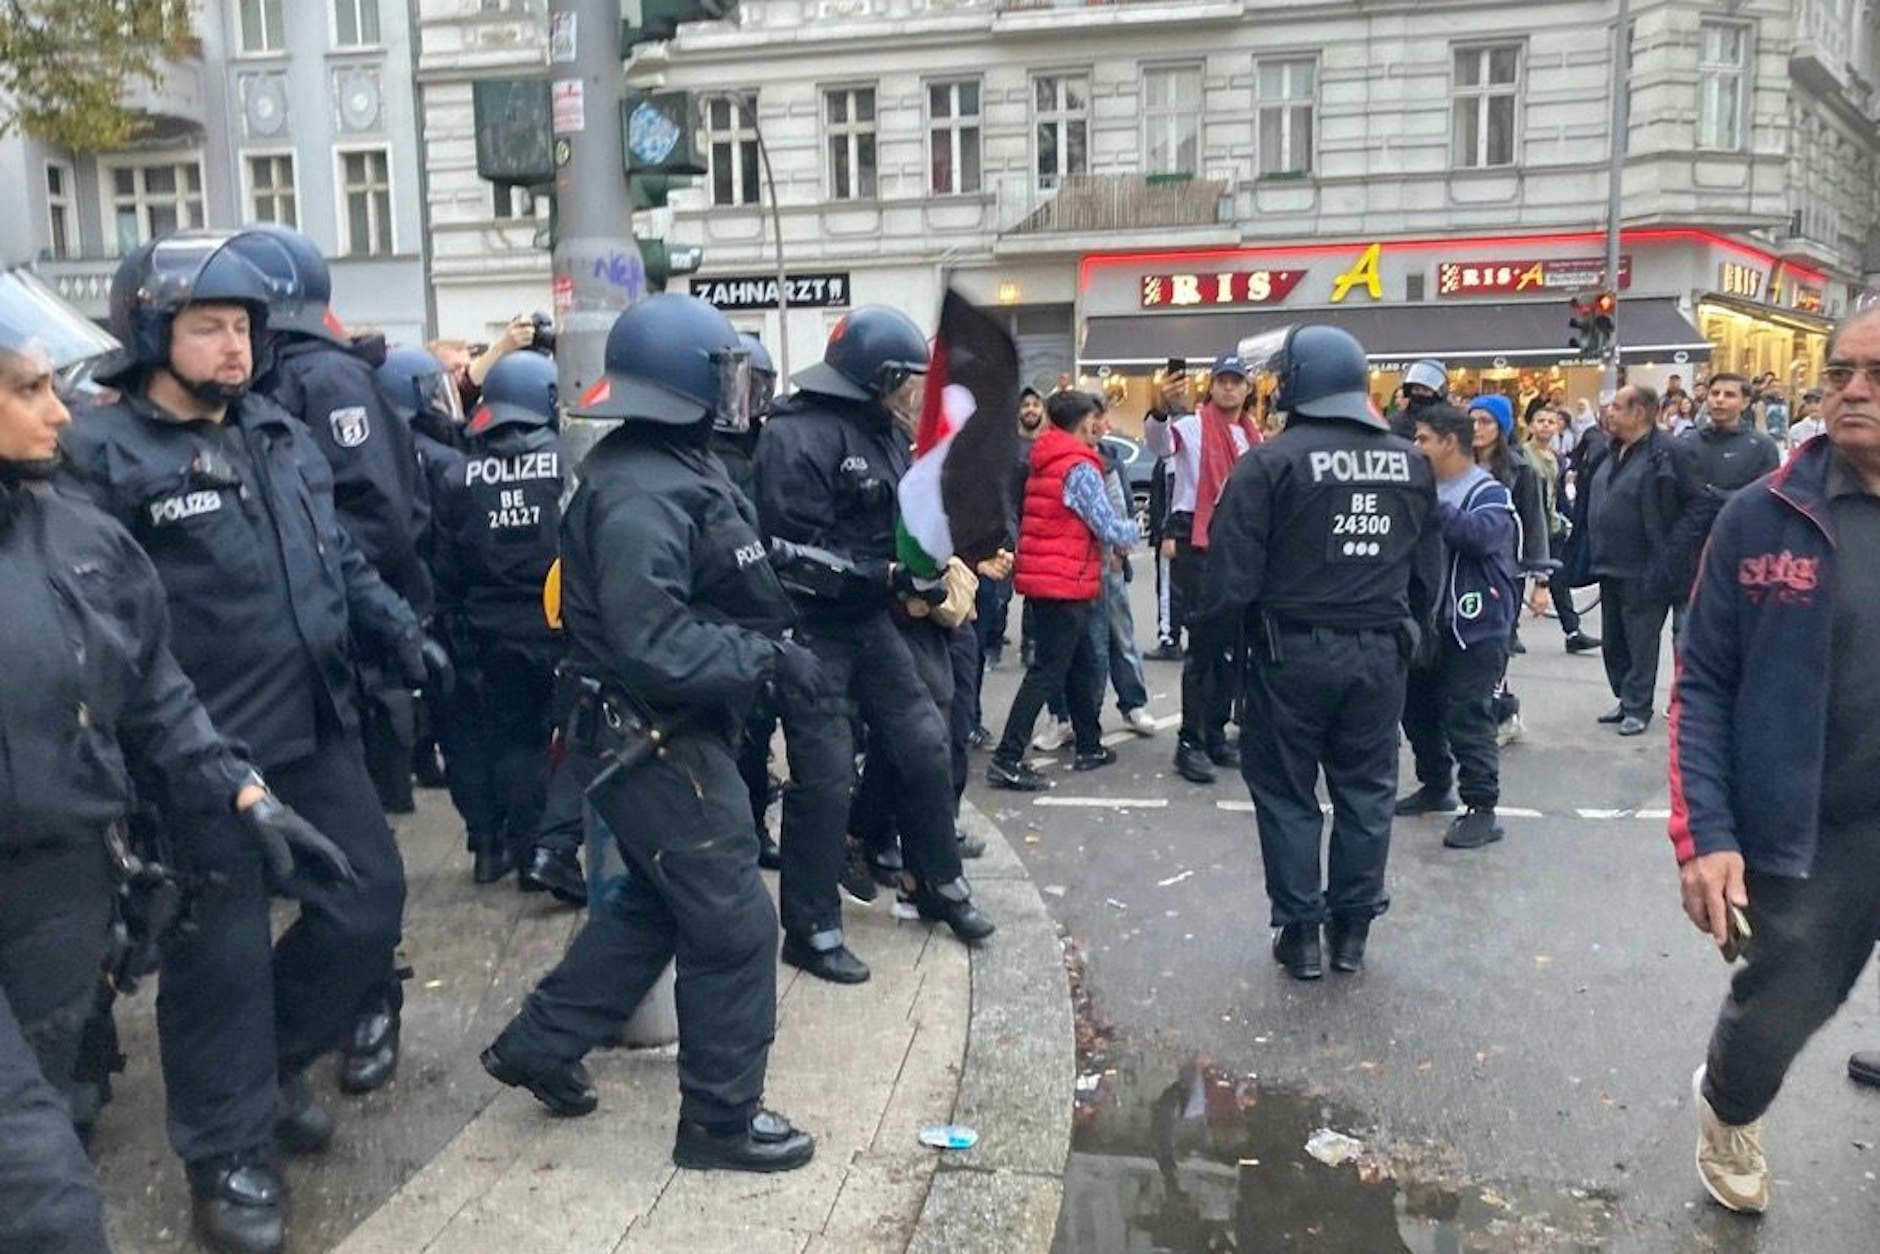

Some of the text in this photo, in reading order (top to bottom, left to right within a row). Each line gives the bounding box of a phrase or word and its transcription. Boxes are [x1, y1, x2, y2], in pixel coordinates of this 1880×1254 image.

[697, 278, 825, 305] ZAHNARZT
[466, 452, 558, 487] POLIZEI
[1310, 450, 1410, 482] POLIZEI
[501, 489, 524, 509] BE
[1351, 493, 1378, 513] BE
[488, 505, 541, 529] 24127
[1333, 514, 1392, 535] 24300
